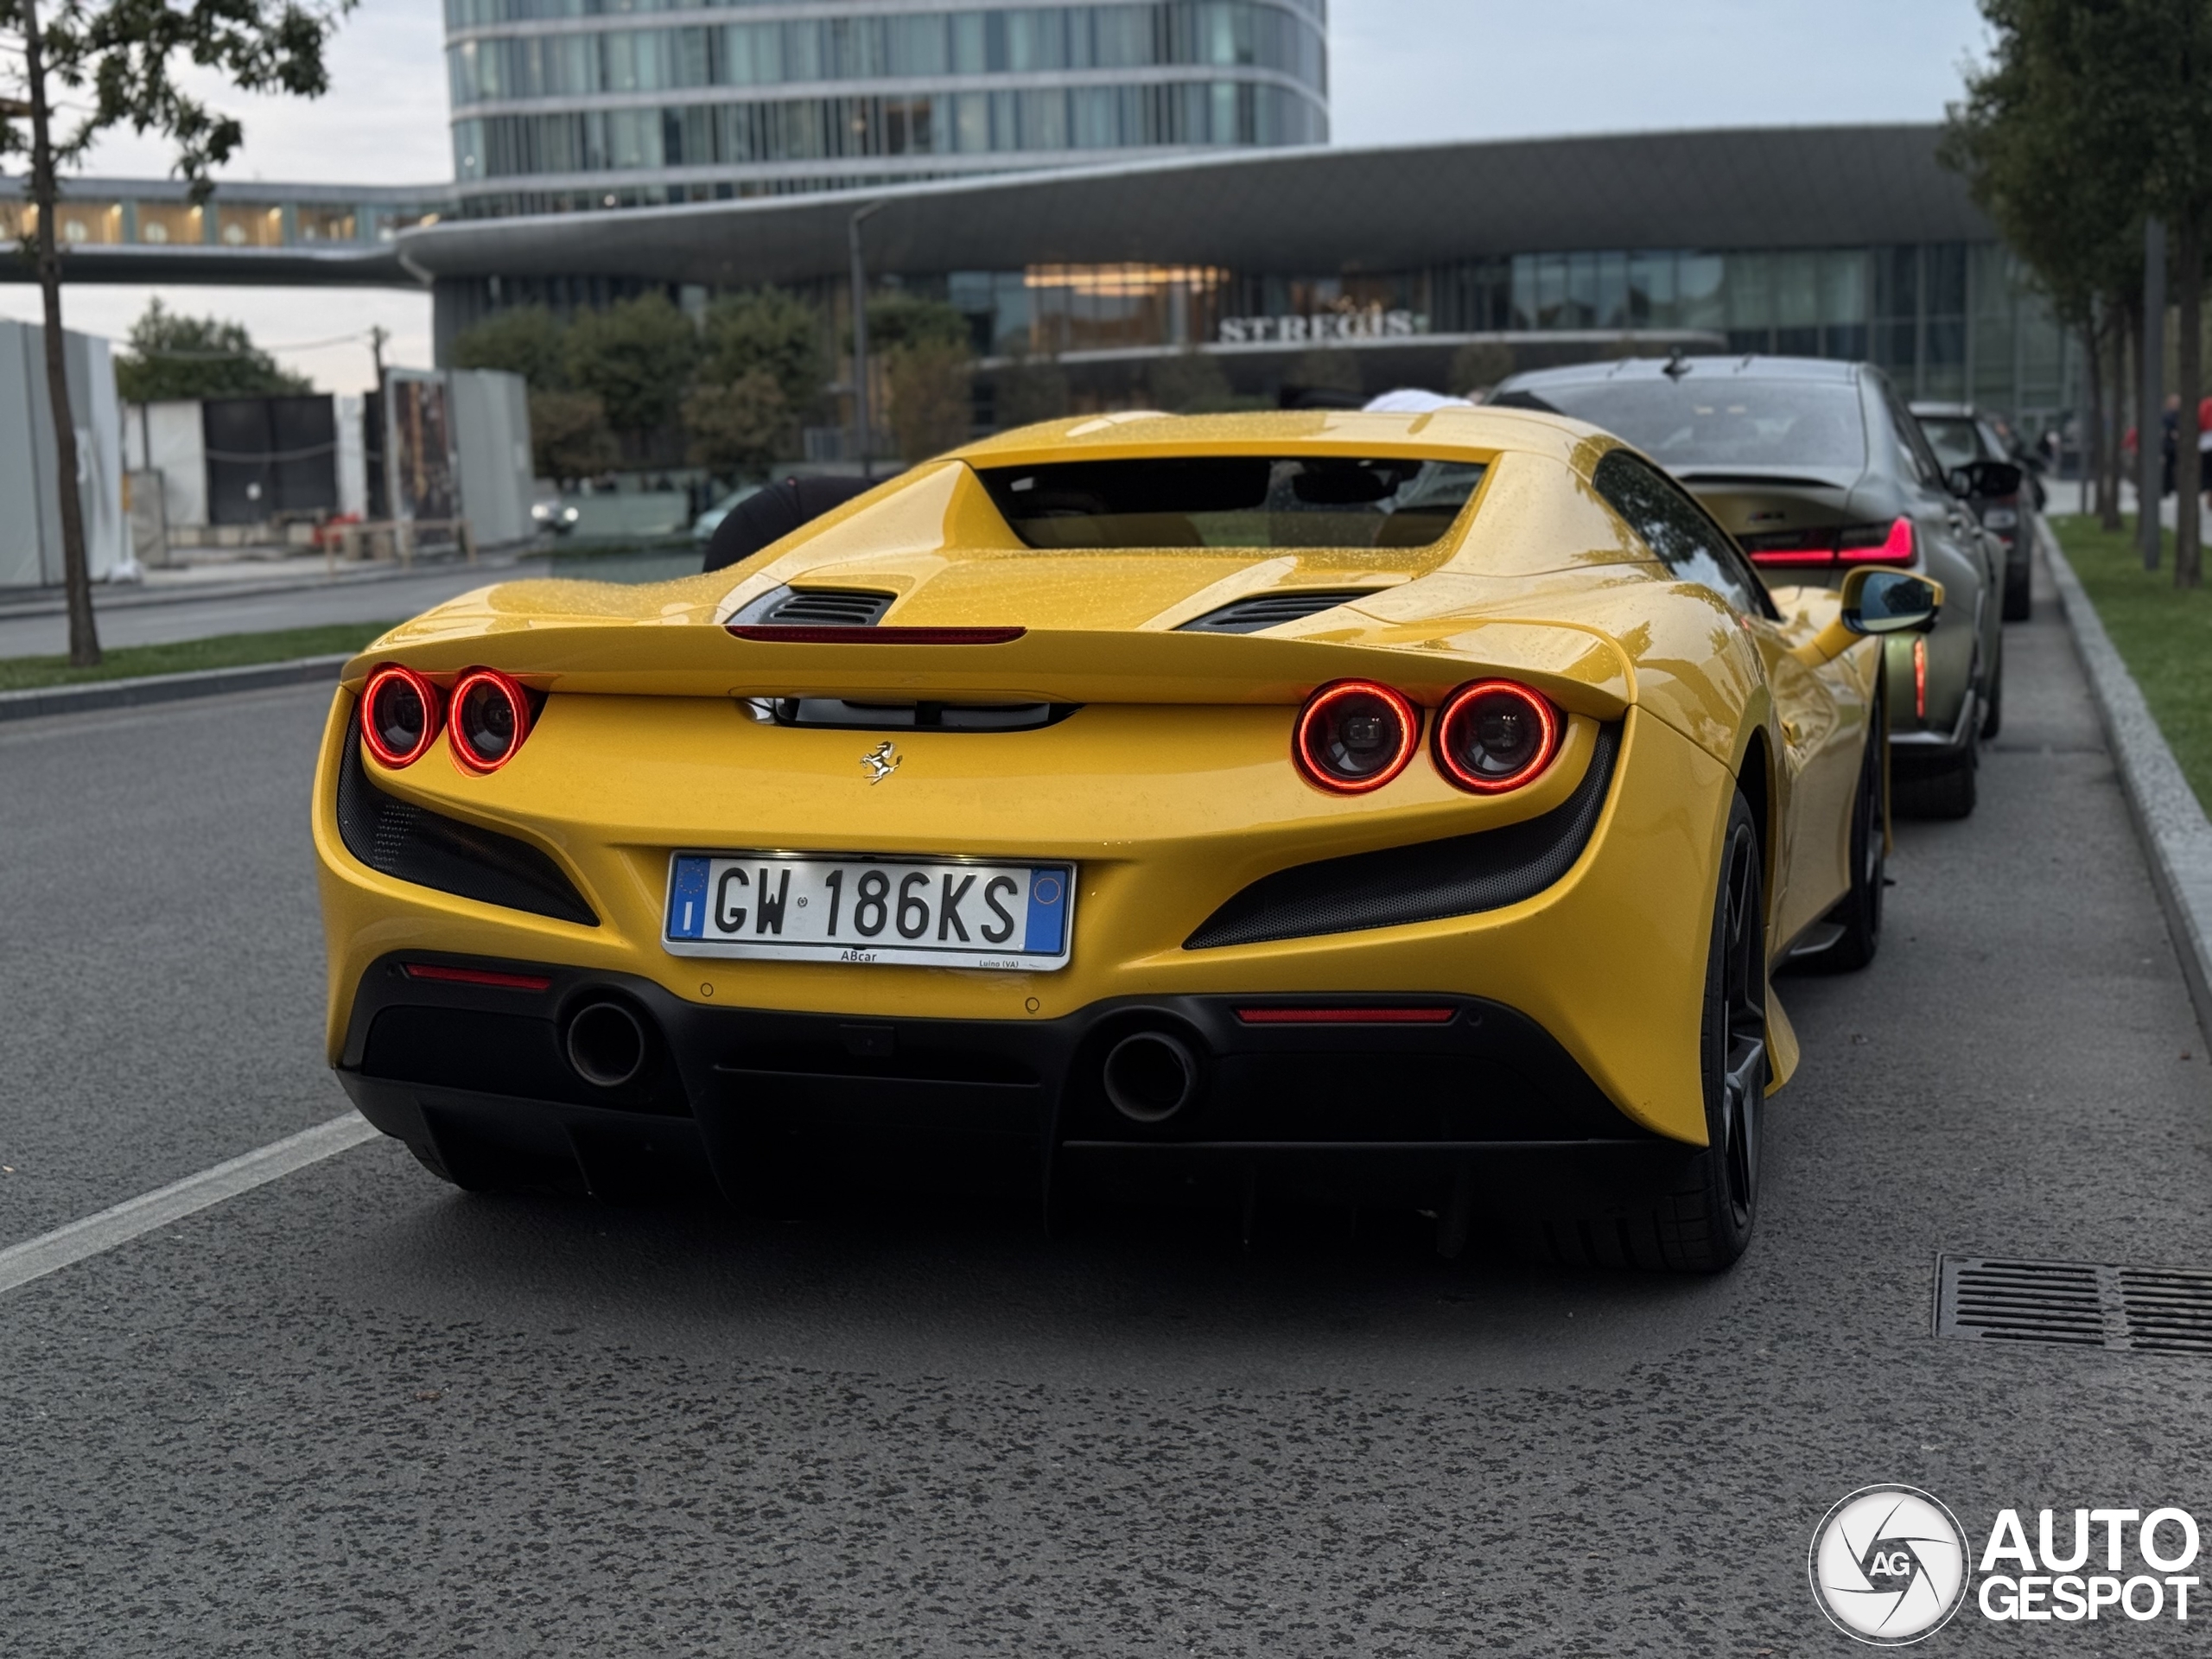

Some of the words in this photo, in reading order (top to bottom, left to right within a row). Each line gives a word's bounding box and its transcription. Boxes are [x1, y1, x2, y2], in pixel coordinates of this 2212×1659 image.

[715, 867, 791, 934] GW
[824, 869, 1018, 942] 186KS
[841, 950, 877, 962] ABcar
[979, 959, 1001, 968] Luino
[1002, 960, 1019, 969] (VA)
